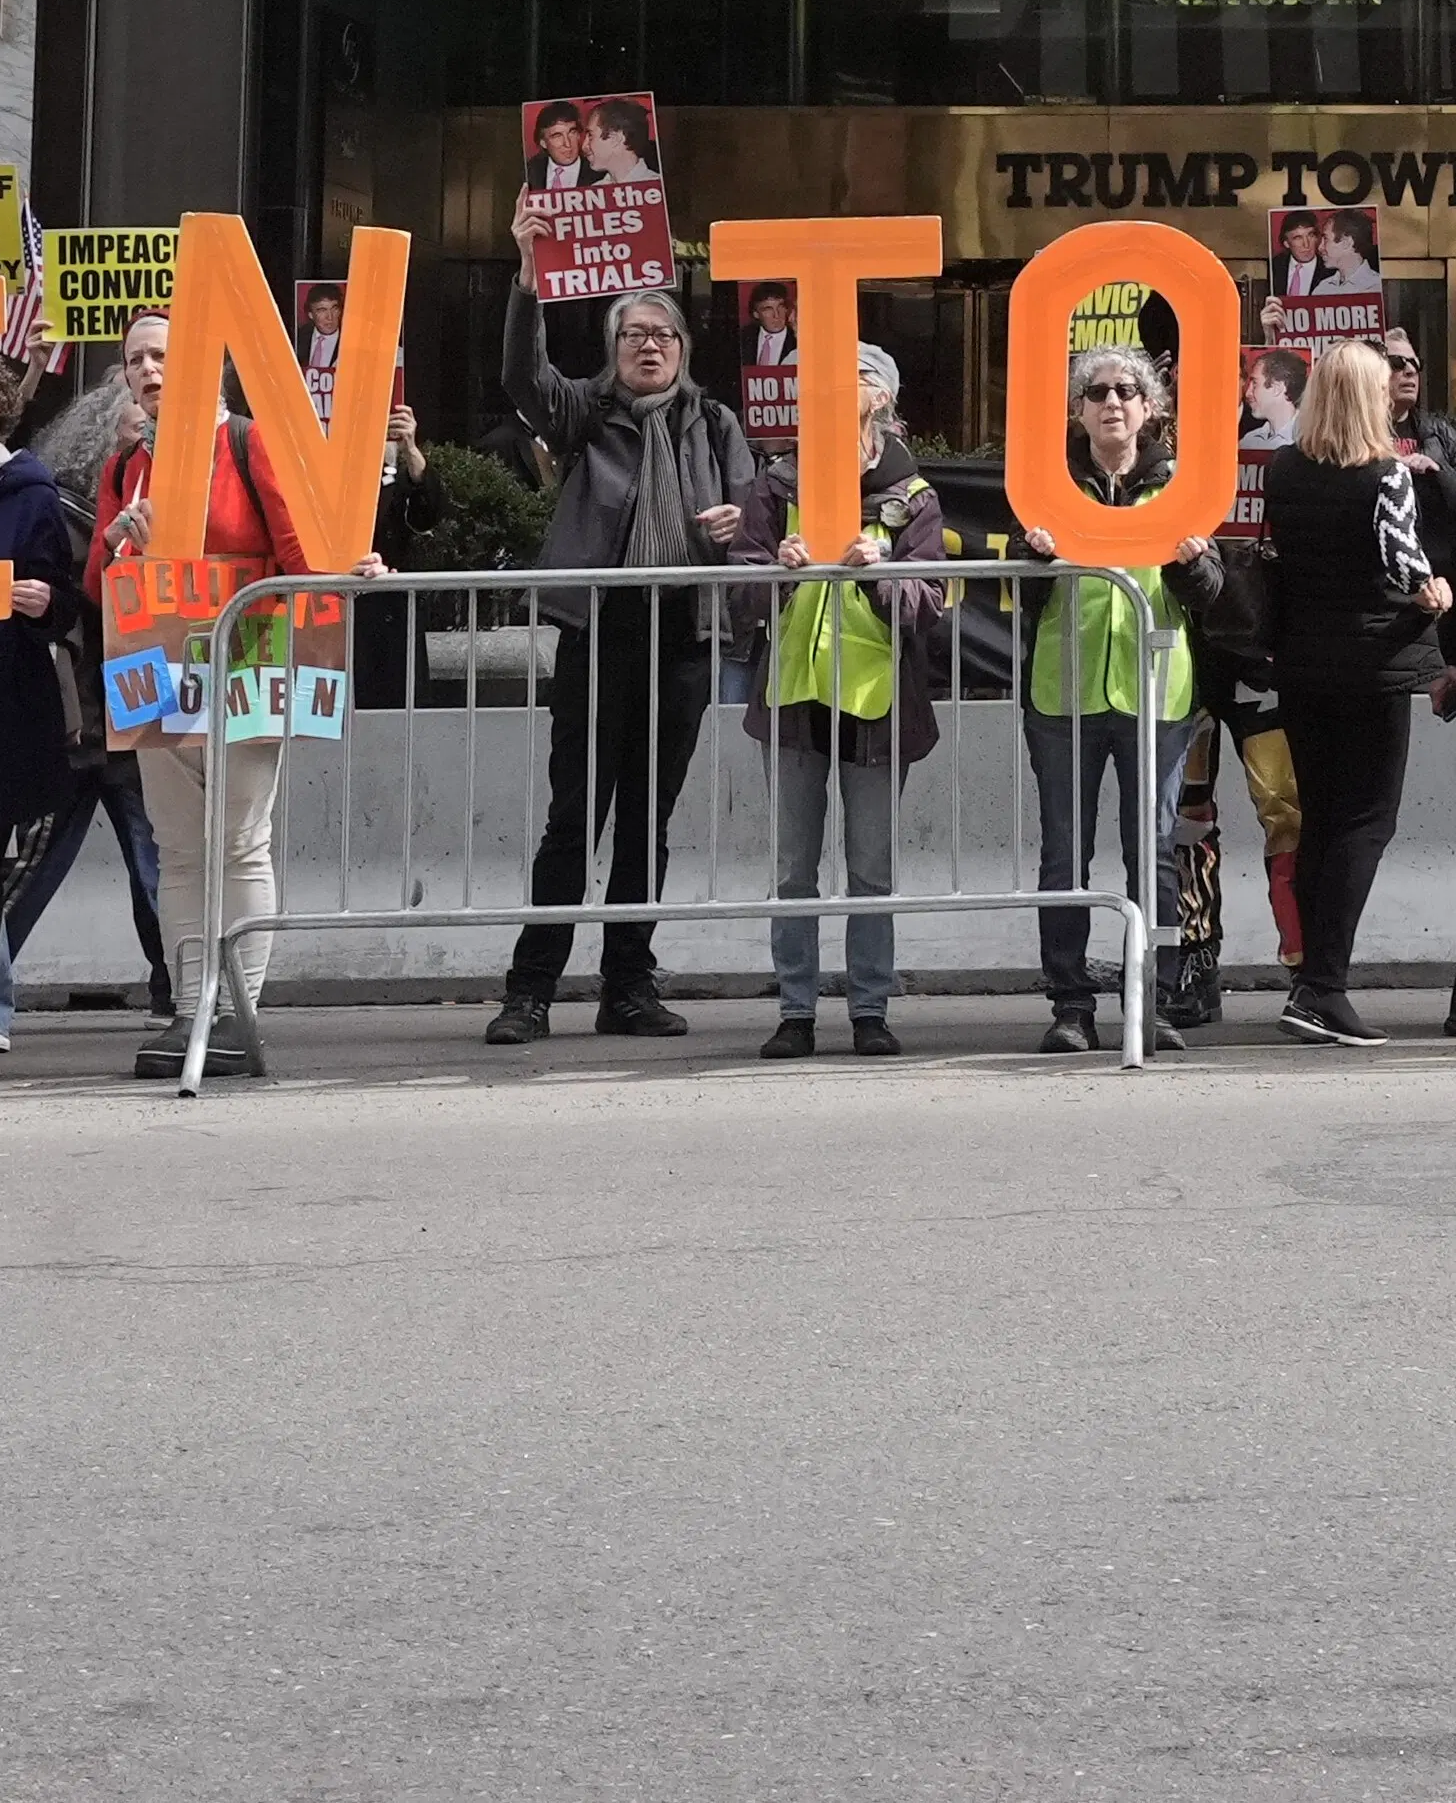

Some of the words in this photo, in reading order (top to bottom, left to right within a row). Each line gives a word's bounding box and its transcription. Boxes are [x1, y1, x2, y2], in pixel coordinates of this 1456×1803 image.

[996, 150, 1258, 209] TRUMP
[527, 190, 607, 216] TURN
[613, 185, 663, 208] the
[555, 210, 644, 241] FILES
[58, 233, 179, 265] IMPEAC
[573, 241, 632, 265] into
[59, 268, 175, 301] CONVIC
[544, 260, 665, 297] TRIALS
[1281, 307, 1310, 333] NO
[1315, 305, 1380, 331] MORE
[709, 214, 1241, 568] TO
[747, 377, 779, 401] NO
[113, 662, 338, 718] WOMEN
